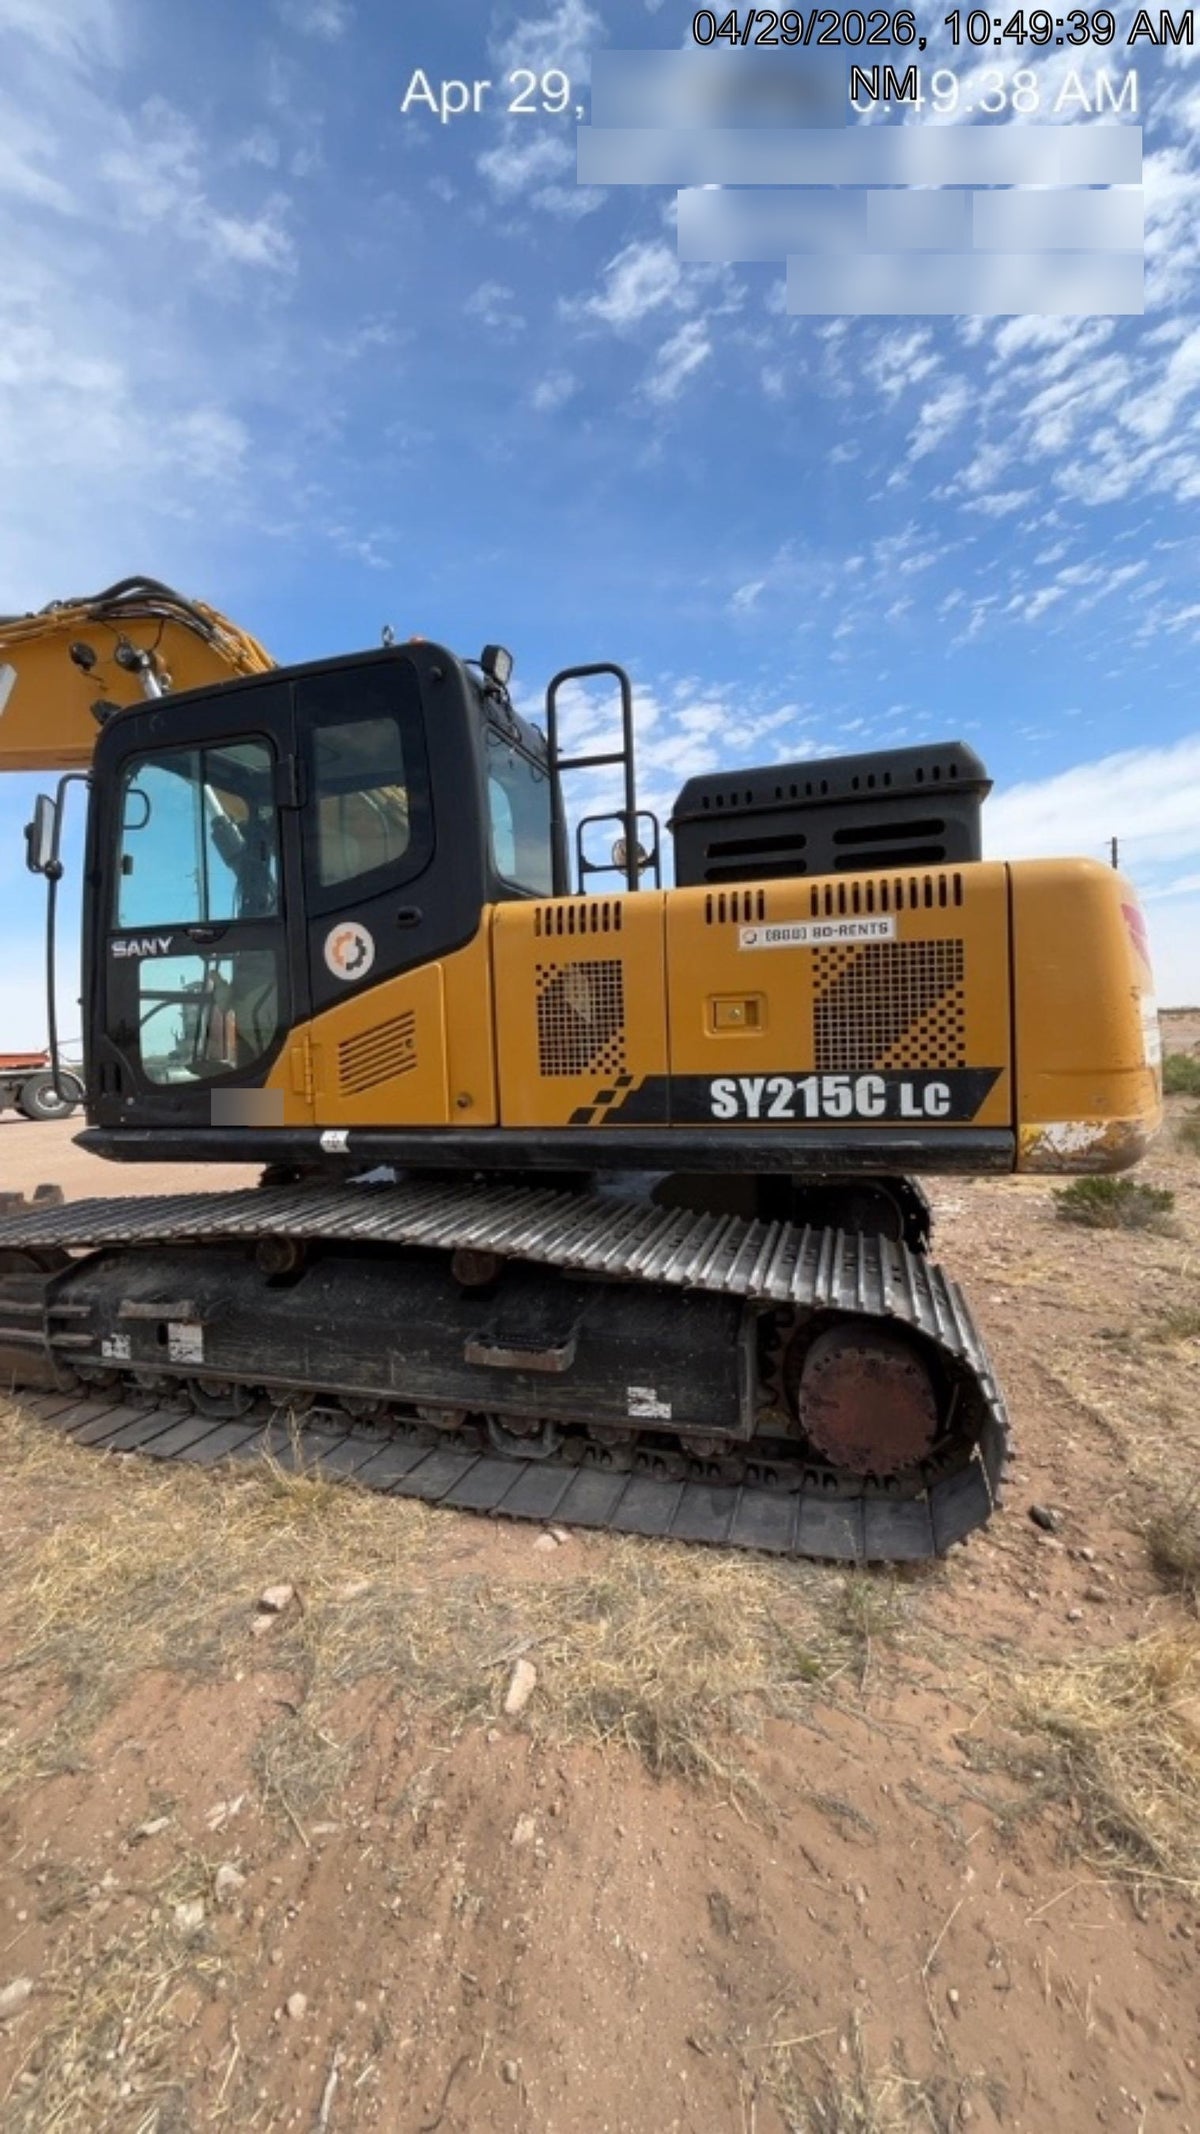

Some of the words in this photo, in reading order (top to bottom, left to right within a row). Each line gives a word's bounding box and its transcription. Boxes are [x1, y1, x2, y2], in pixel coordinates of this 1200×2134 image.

[111, 935, 174, 959] SANY
[710, 1074, 886, 1119] SY215C
[900, 1082, 951, 1117] LC
